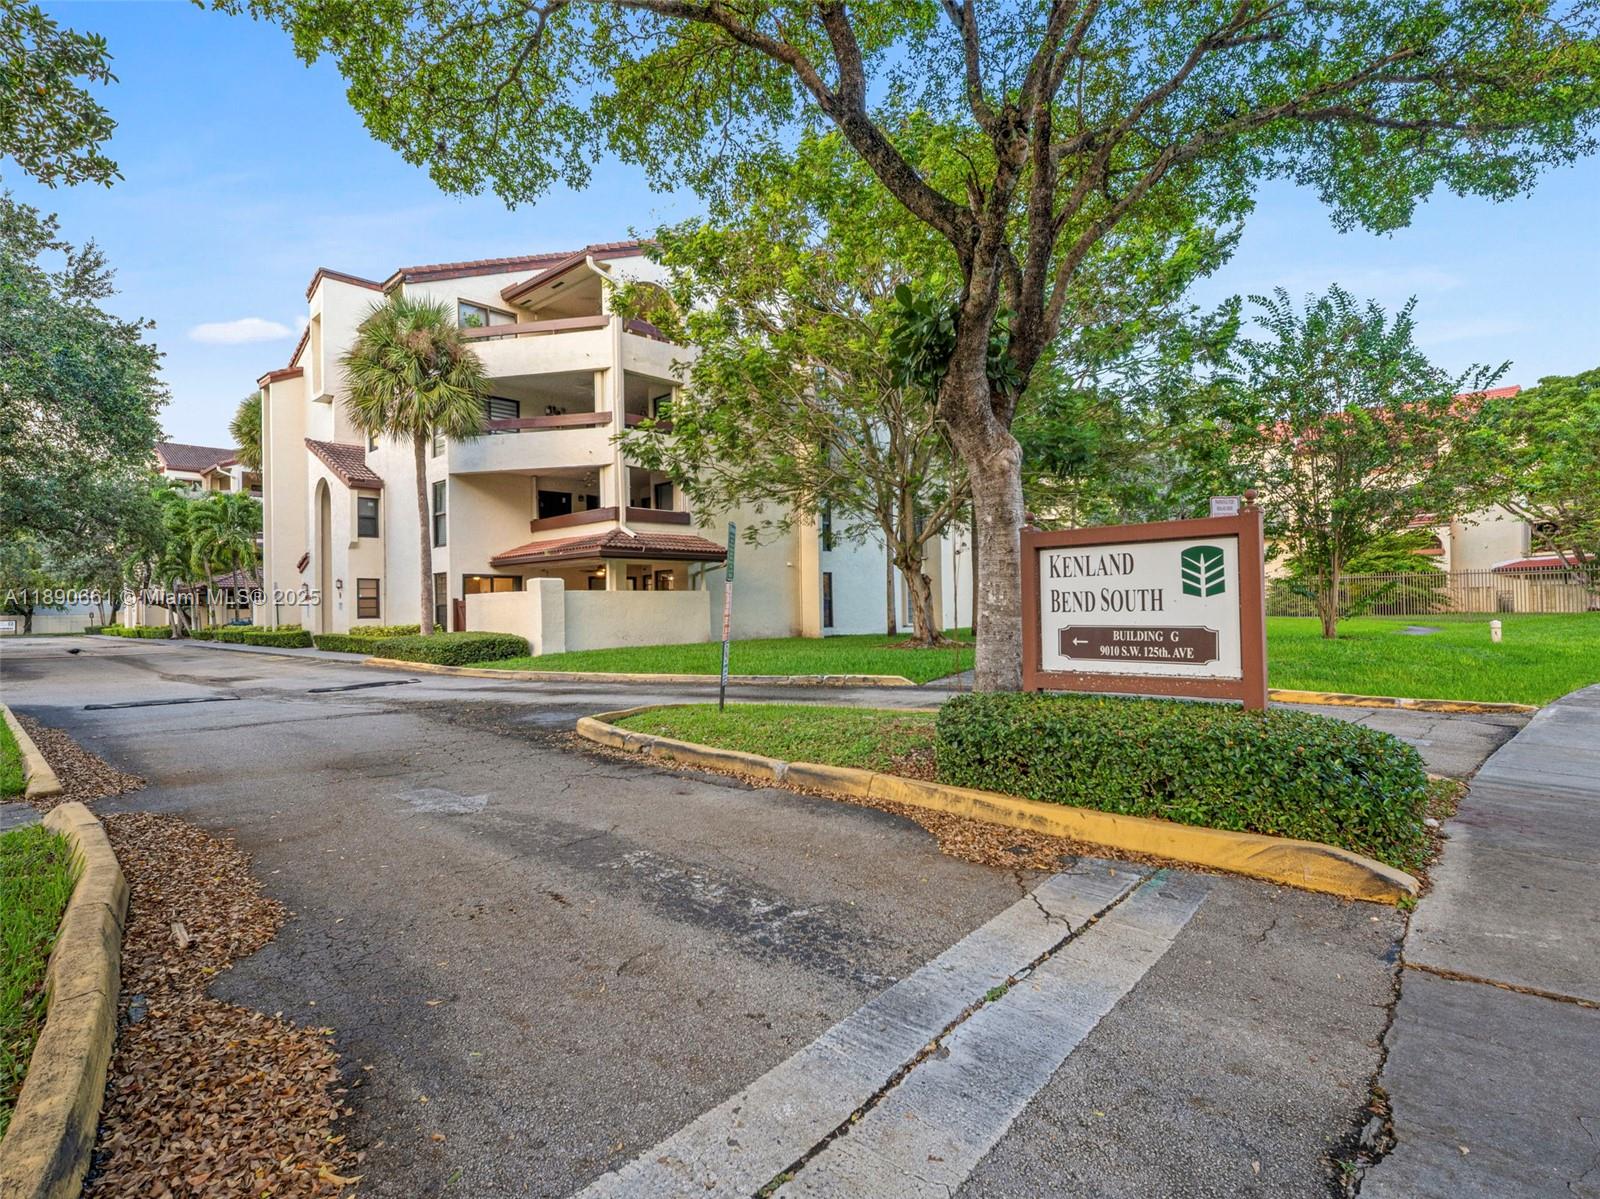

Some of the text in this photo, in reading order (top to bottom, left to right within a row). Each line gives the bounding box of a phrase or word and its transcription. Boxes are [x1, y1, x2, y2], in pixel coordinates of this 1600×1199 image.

[1049, 552, 1134, 579] KENLAND
[1050, 587, 1164, 613] BEND SOUTH
[1113, 630, 1179, 642] BUILDING G
[1099, 645, 1120, 657] 9010
[1121, 646, 1142, 657] S.W.
[1172, 647, 1195, 659] AVE
